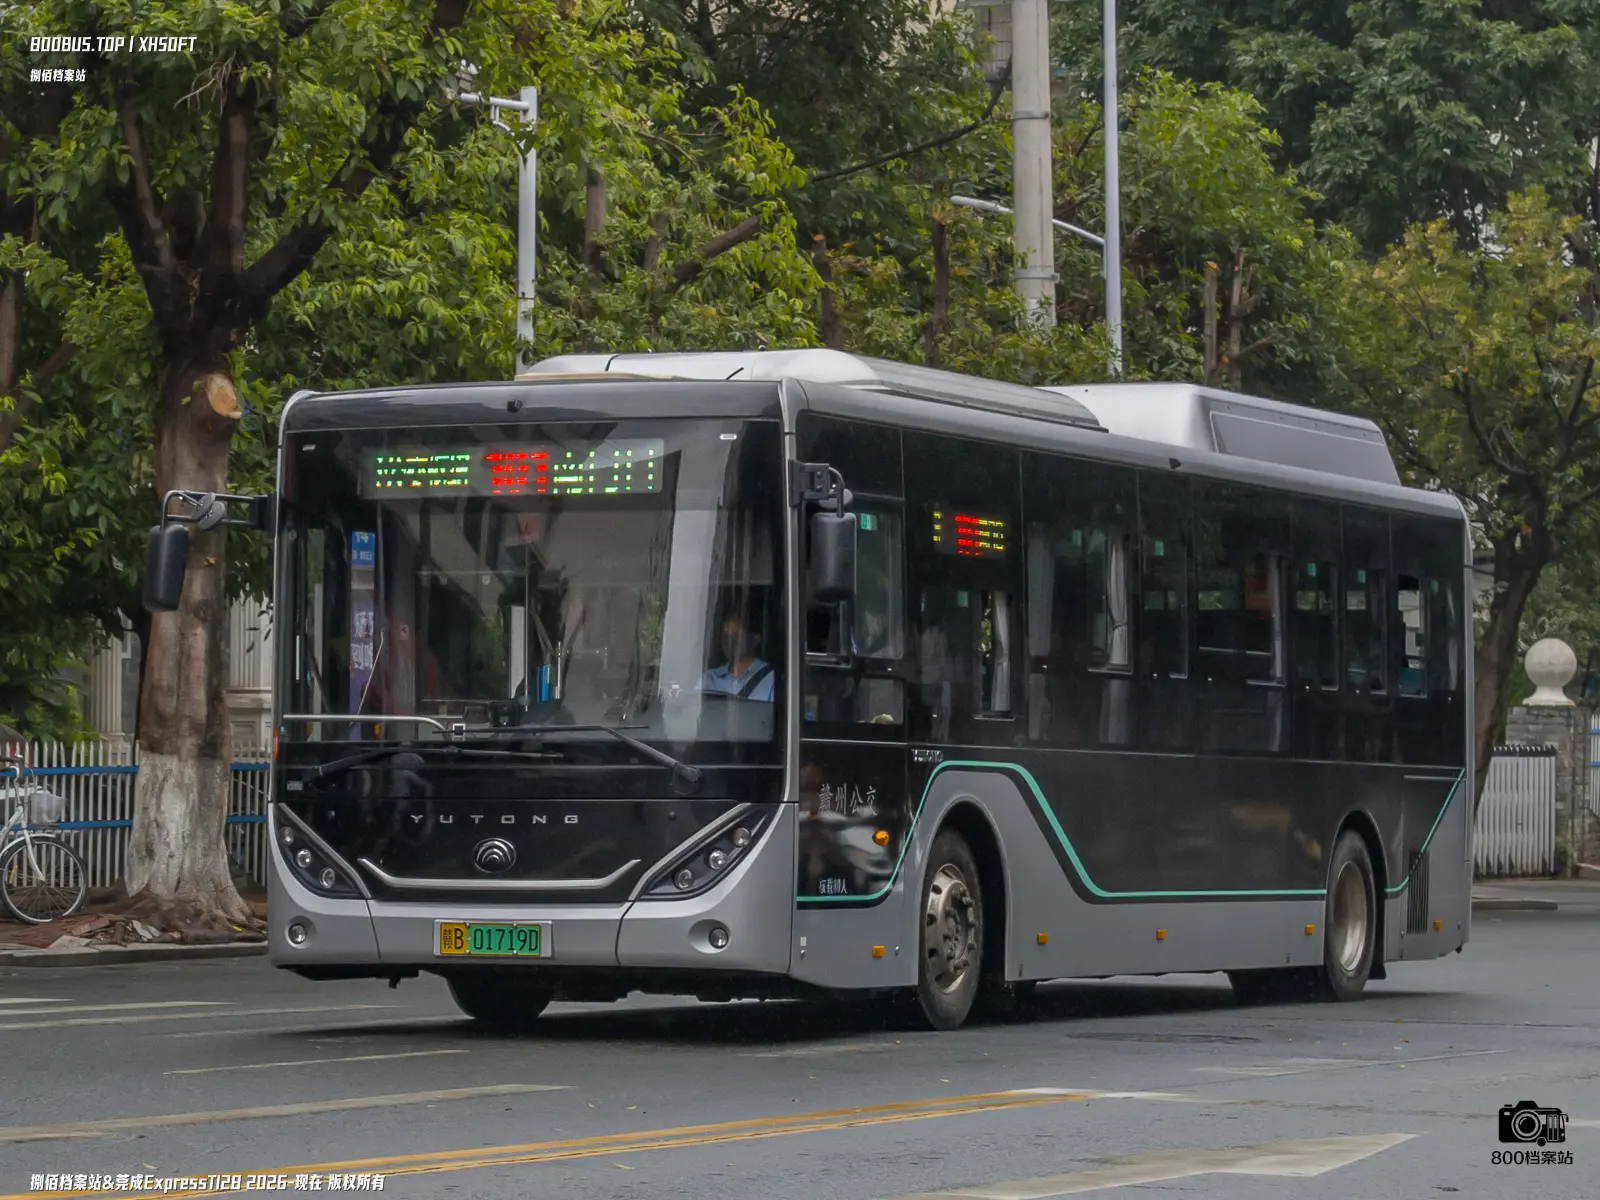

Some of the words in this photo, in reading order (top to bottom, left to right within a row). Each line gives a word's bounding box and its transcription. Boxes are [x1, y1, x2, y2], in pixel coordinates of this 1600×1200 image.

[818, 782, 879, 817] 赣州公交
[410, 814, 578, 824] YUTONG
